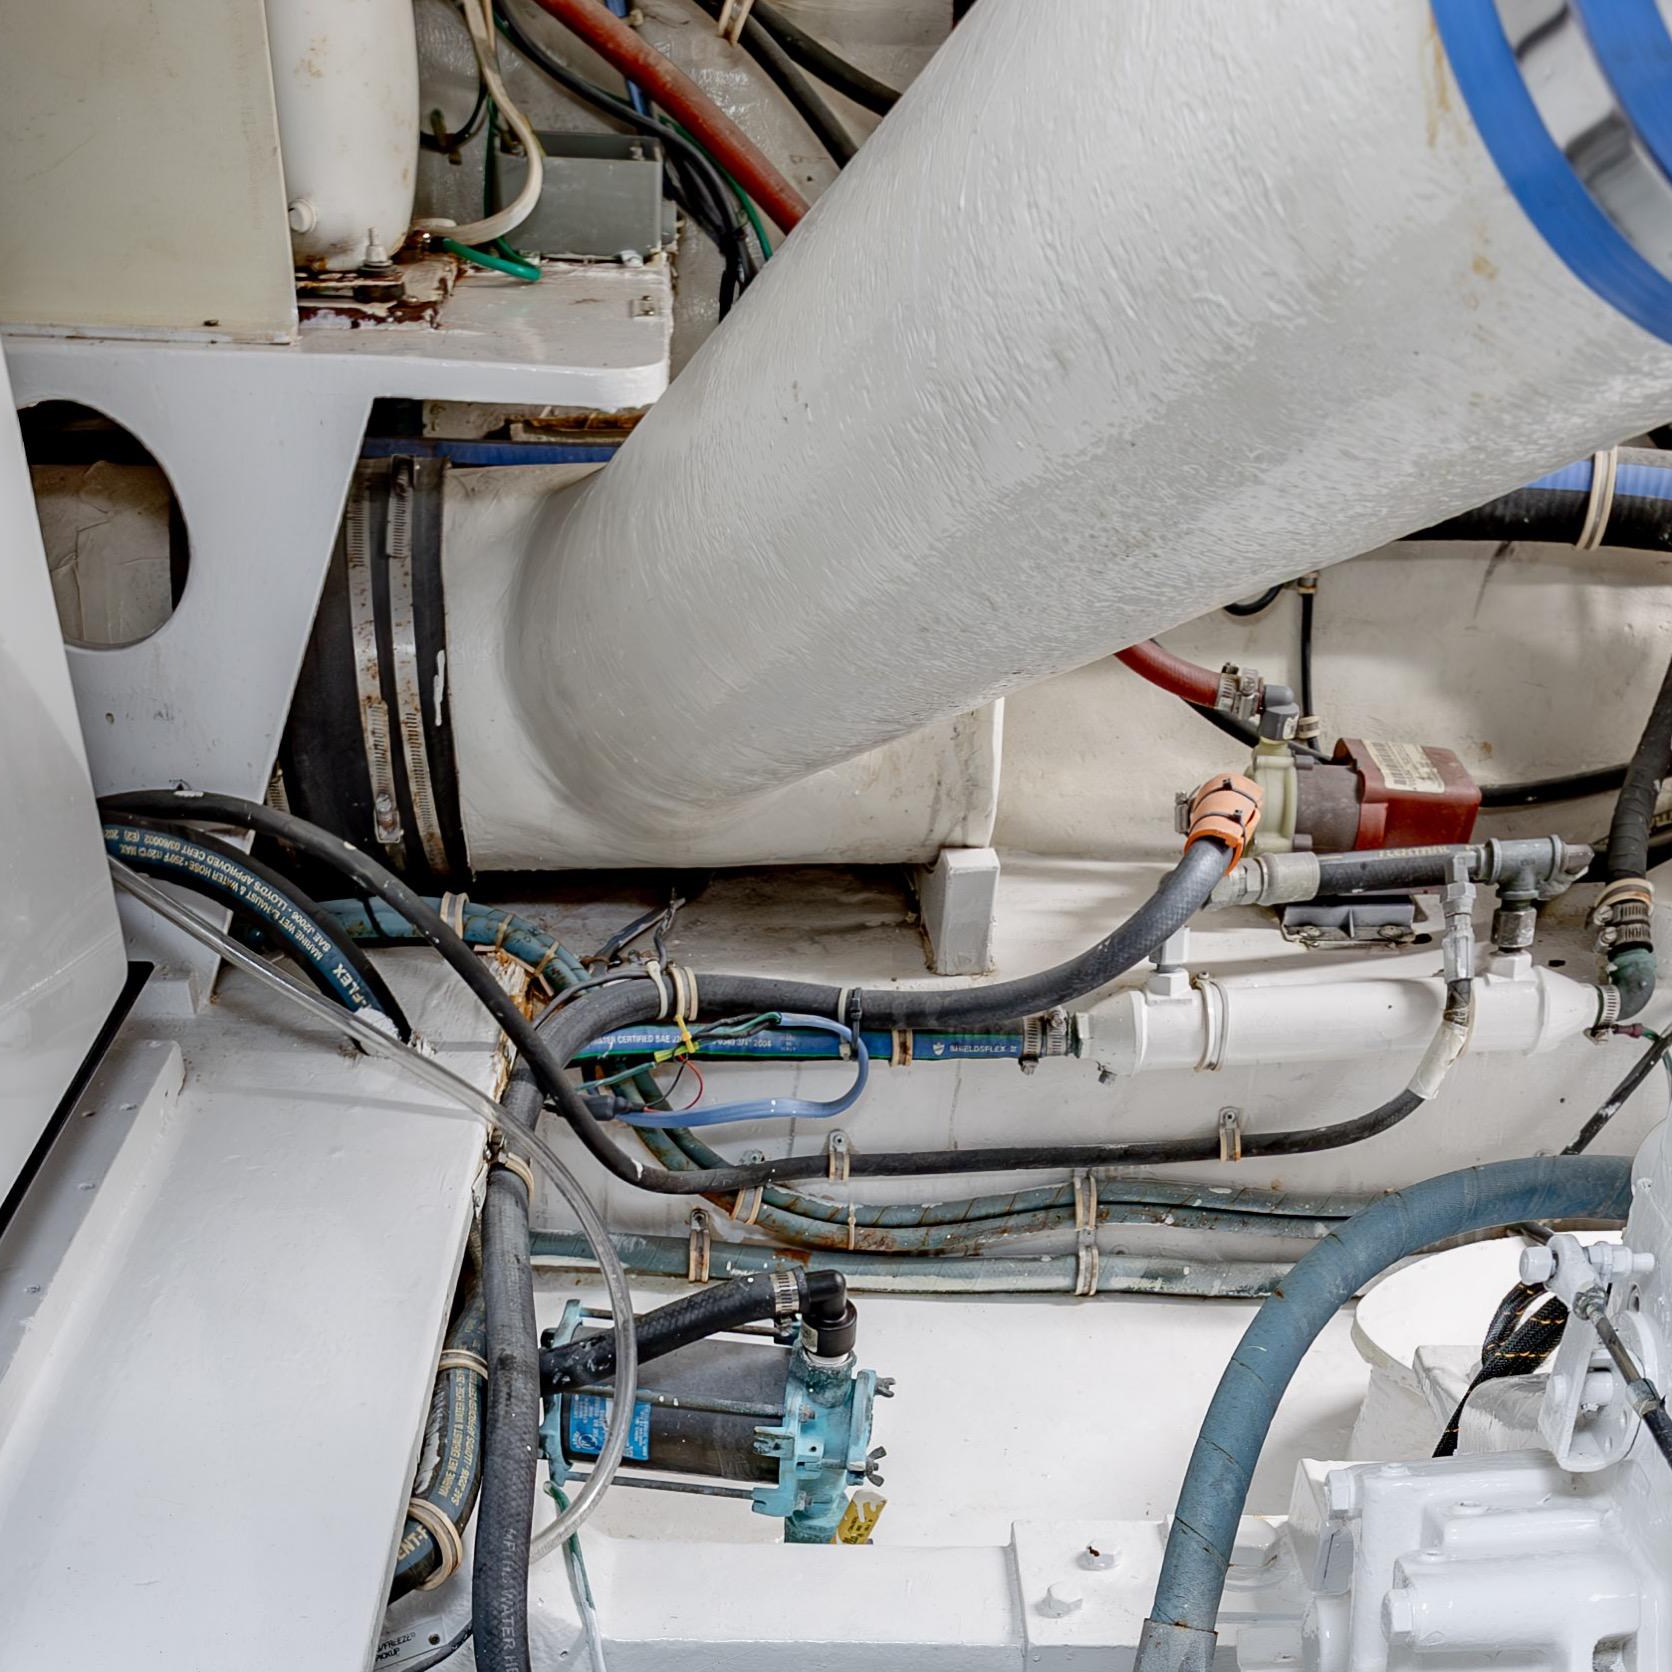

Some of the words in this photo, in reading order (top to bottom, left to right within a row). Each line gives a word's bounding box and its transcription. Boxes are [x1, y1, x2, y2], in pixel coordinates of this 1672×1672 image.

[205, 853, 254, 886] APPROVED
[277, 914, 296, 934] WET
[294, 930, 324, 961] MARINE
